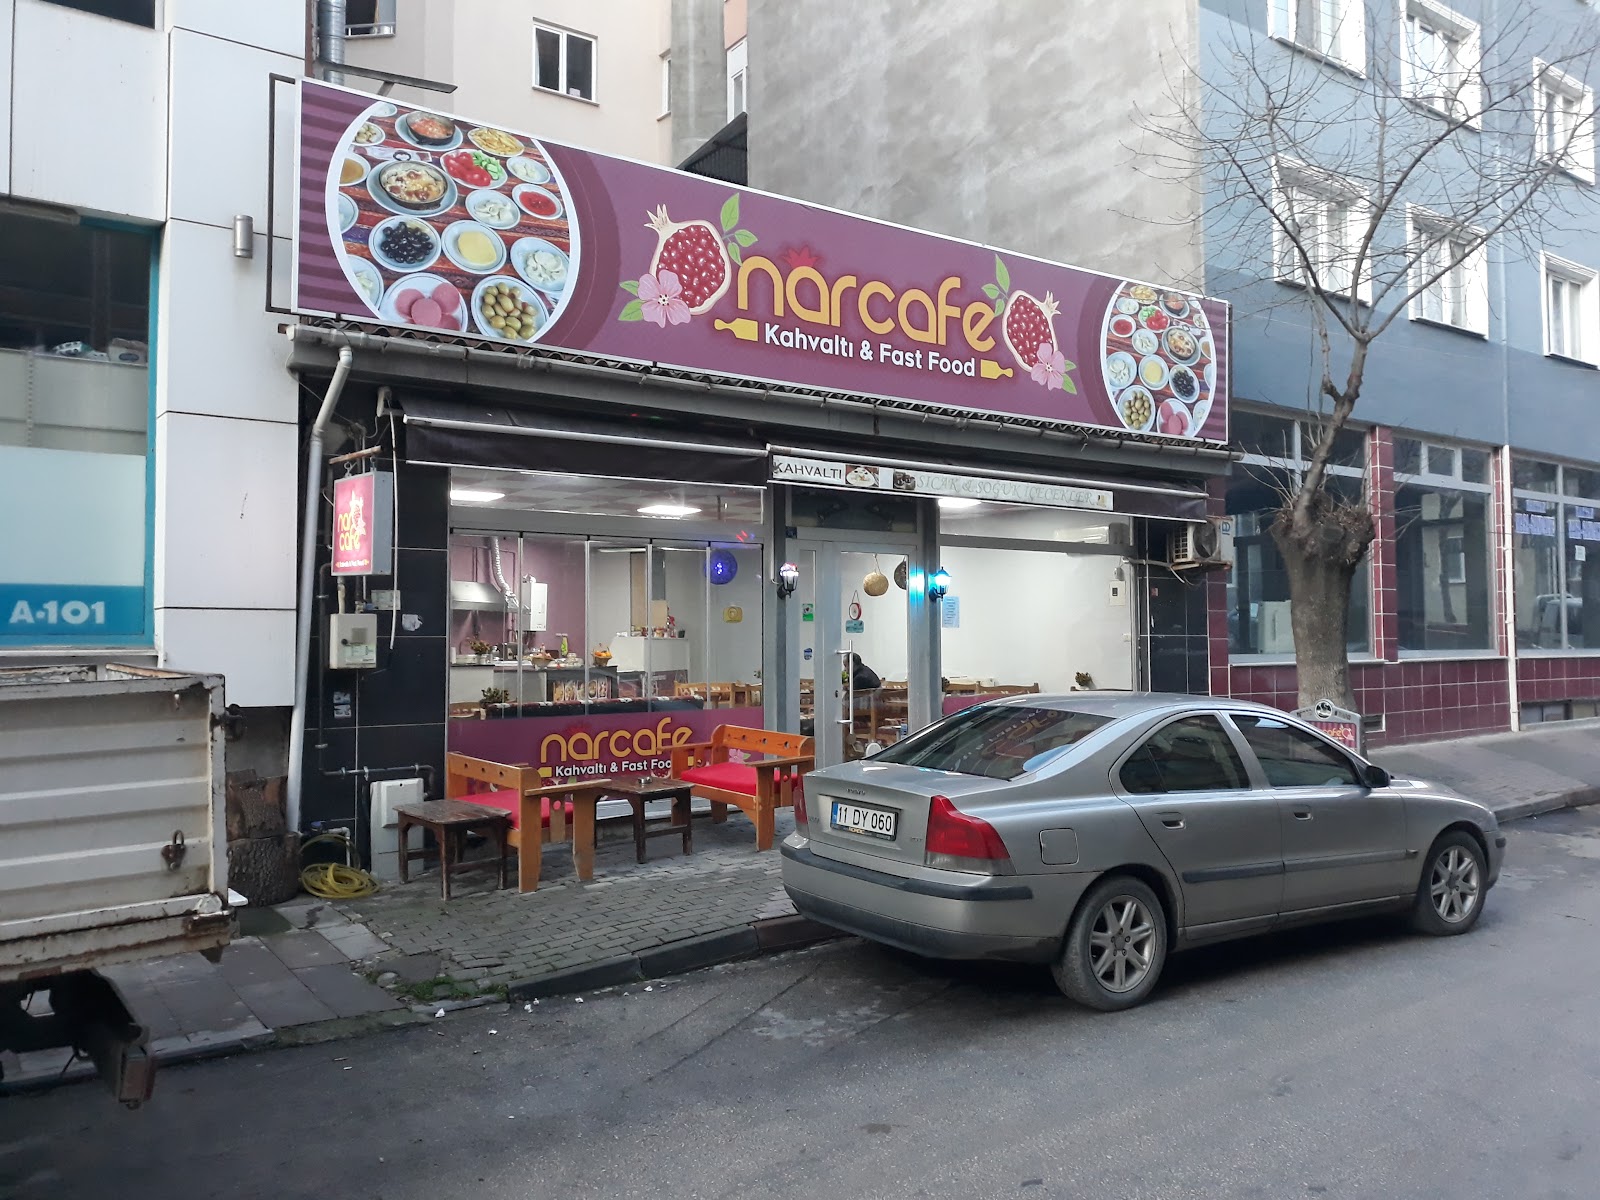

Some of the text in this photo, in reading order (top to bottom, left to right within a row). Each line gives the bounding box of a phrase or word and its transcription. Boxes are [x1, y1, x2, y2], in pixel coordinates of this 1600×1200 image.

[737, 256, 996, 352] narcafe
[765, 323, 975, 377] Kahvaltı & Fast Food
[772, 461, 842, 480] KAHVALTI
[917, 474, 960, 493] SICAK
[541, 717, 693, 763] narcafe
[556, 759, 672, 777] Kahvaltı & Fast Foo
[838, 806, 848, 823] 11
[852, 810, 869, 828] DY
[871, 814, 892, 832] 060
